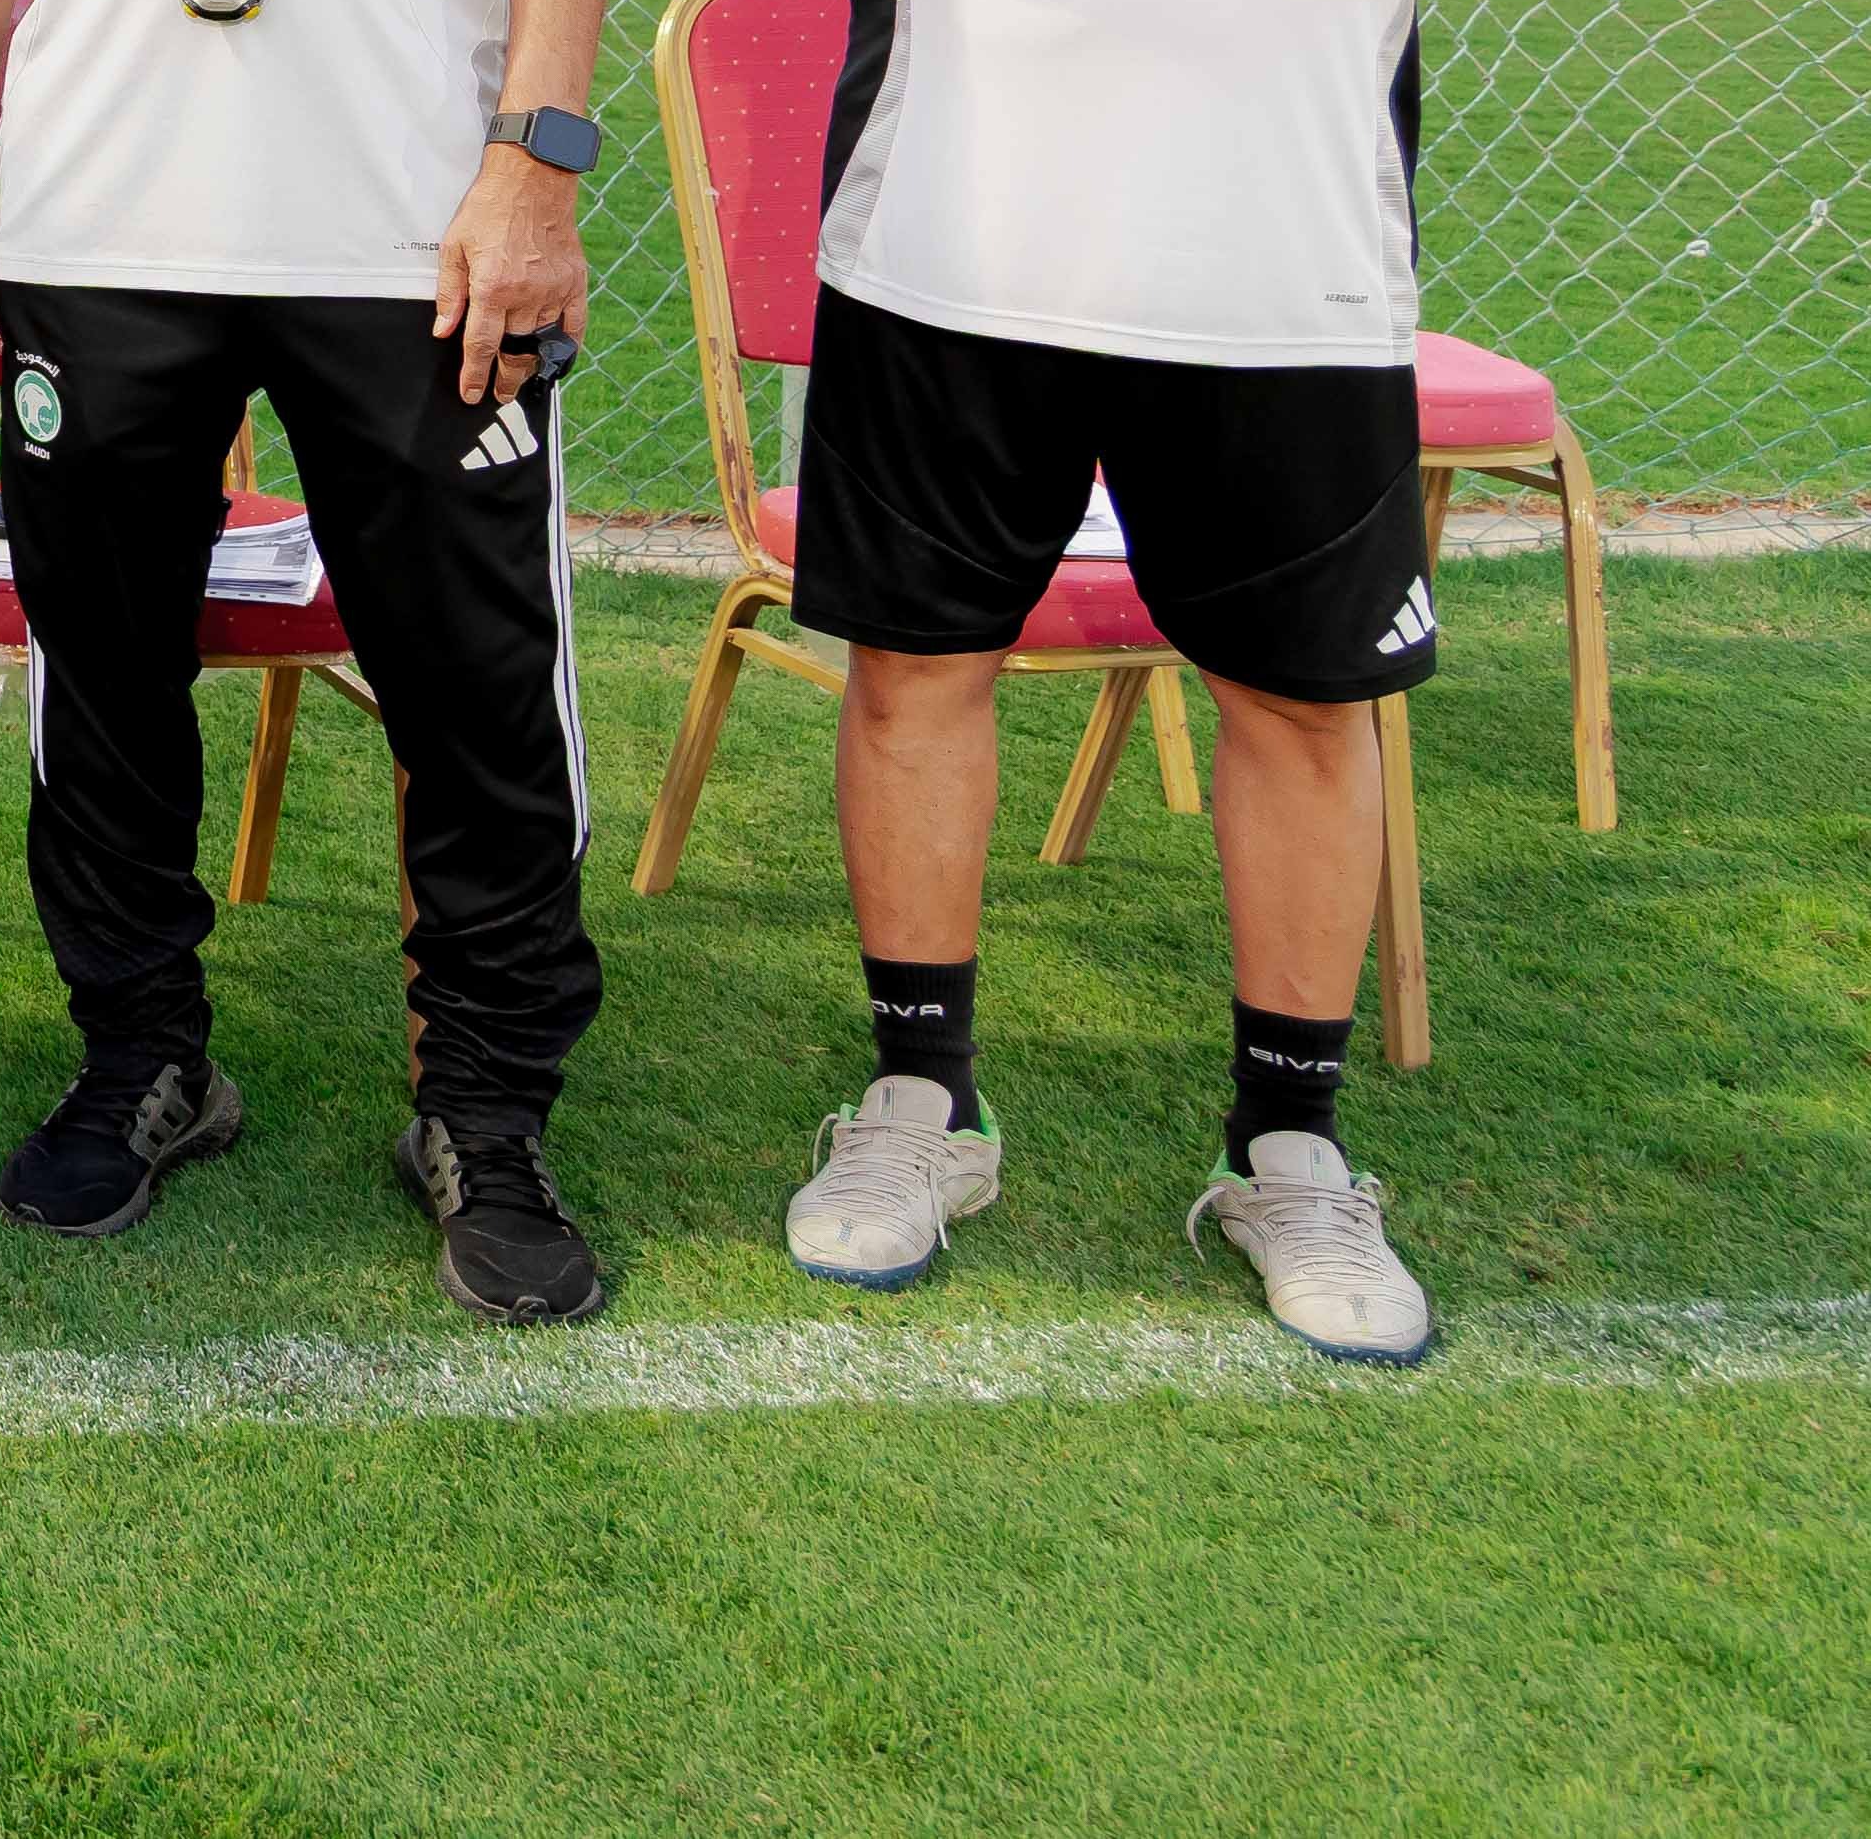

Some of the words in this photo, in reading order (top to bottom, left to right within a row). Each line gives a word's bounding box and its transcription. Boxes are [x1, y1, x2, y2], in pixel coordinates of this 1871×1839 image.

[24, 442, 50, 460] SAUDI
[871, 999, 944, 1018] OVA
[1248, 1045, 1339, 1072] GIVO
